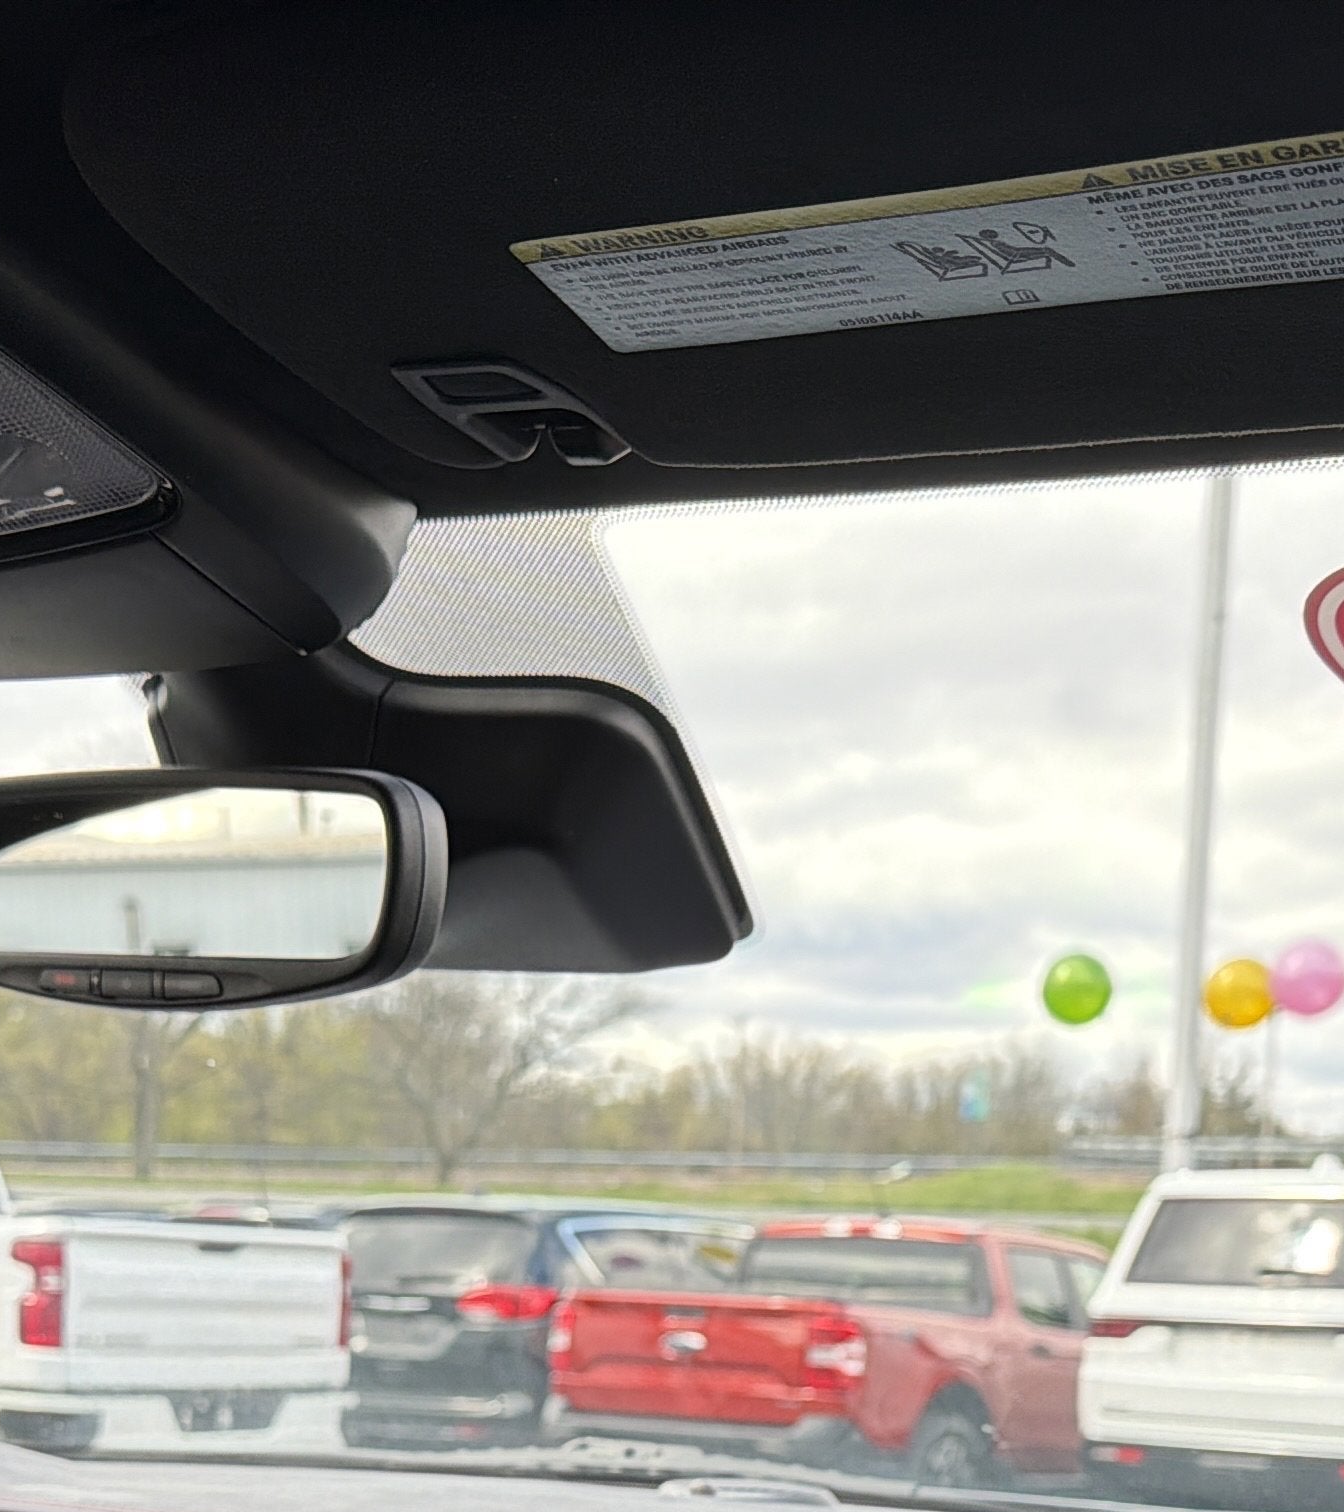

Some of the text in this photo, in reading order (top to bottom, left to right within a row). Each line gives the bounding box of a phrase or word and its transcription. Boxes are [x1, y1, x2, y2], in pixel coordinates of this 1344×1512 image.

[1125, 158, 1213, 180] MISE
[1216, 151, 1264, 167] EN
[1085, 188, 1144, 204] MÊME
[1144, 182, 1194, 196] AVEC
[1196, 177, 1234, 189] DES
[1236, 169, 1286, 184] SACS
[572, 225, 711, 252] WARNING
[1265, 234, 1284, 242] DU
[550, 236, 790, 271] EVEN WITH ADVANCED AIRBAGS
